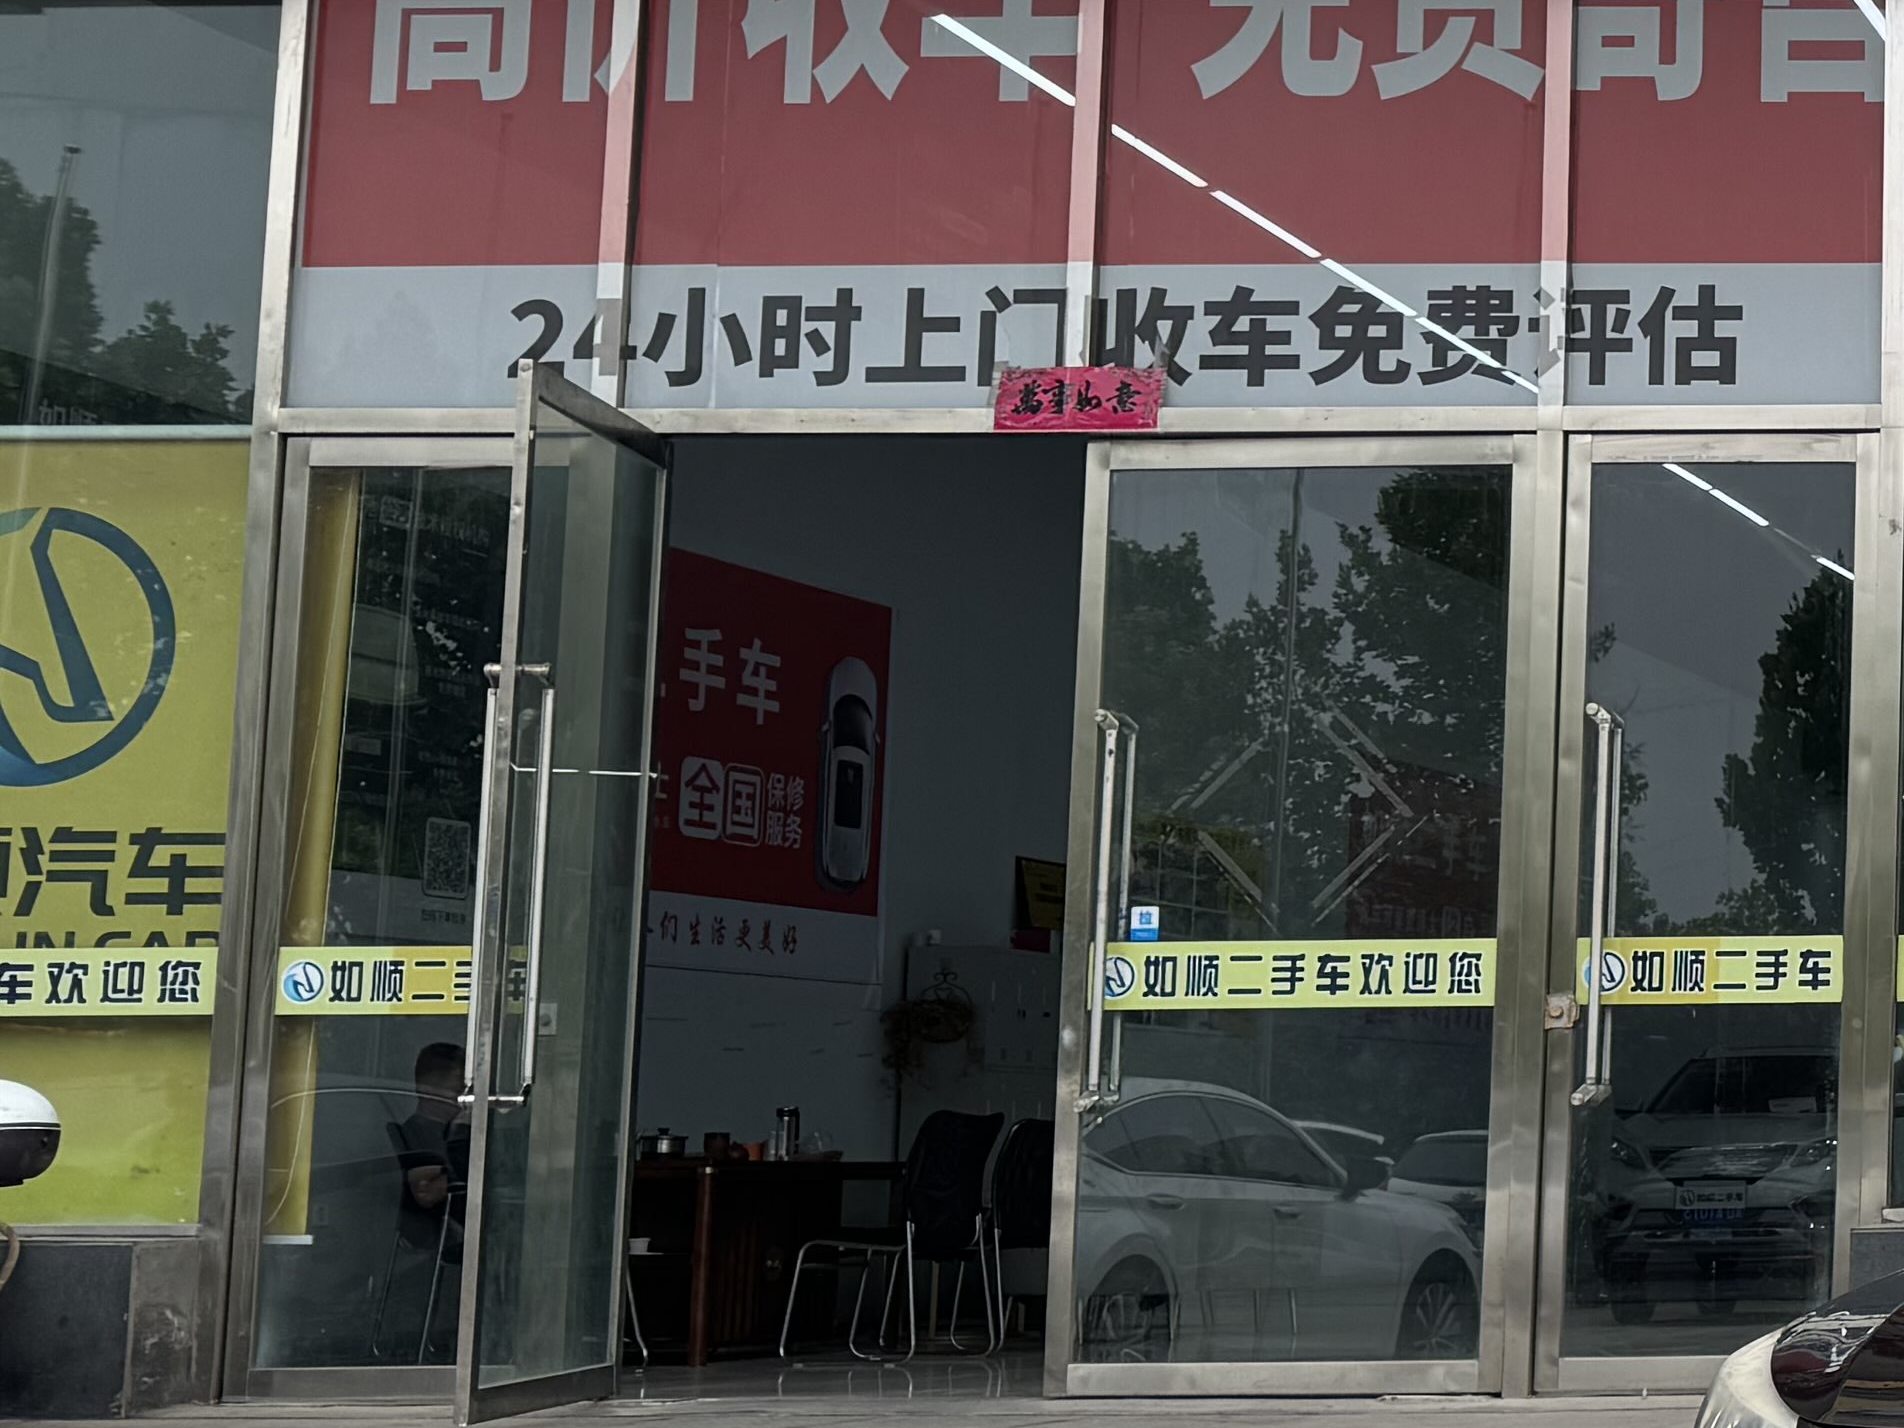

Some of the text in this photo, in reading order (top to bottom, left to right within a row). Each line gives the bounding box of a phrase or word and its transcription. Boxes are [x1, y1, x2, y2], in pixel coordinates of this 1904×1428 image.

[507, 285, 1745, 388] 24小时上门收车免费评估
[660, 627, 781, 725] 手车
[0, 826, 226, 917] 汽车
[648, 911, 799, 956] 们生活更美好
[0, 960, 202, 1005] 车欢迎您
[1142, 951, 1484, 997] 如顺二手车欢迎您
[1630, 949, 1833, 994] 如顺二手车
